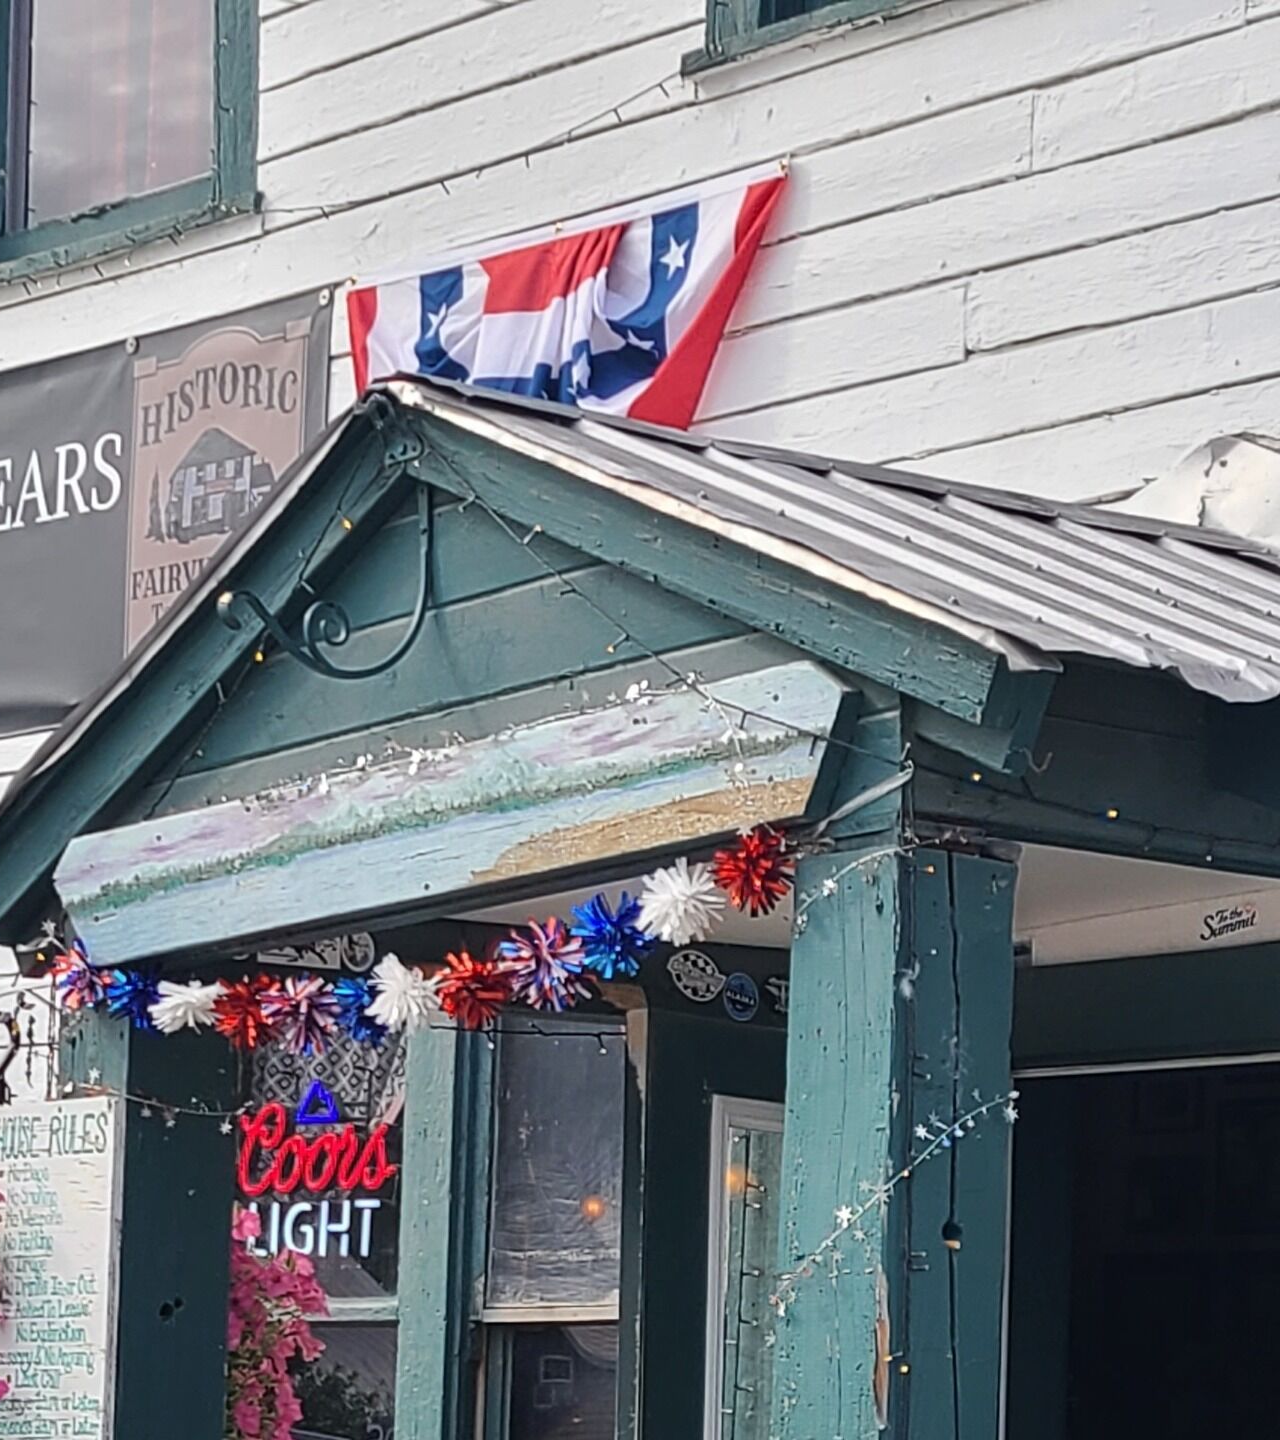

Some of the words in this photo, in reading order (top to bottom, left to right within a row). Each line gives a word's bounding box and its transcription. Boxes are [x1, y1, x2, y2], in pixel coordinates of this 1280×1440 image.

[140, 362, 298, 448] HISTORIC
[131, 557, 213, 600] FAIRV
[1200, 910, 1257, 941] Summit
[1230, 905, 1243, 920] the
[48, 1112, 108, 1158] RULES
[238, 1101, 397, 1194] Coors
[246, 1199, 381, 1257] LIGHT
